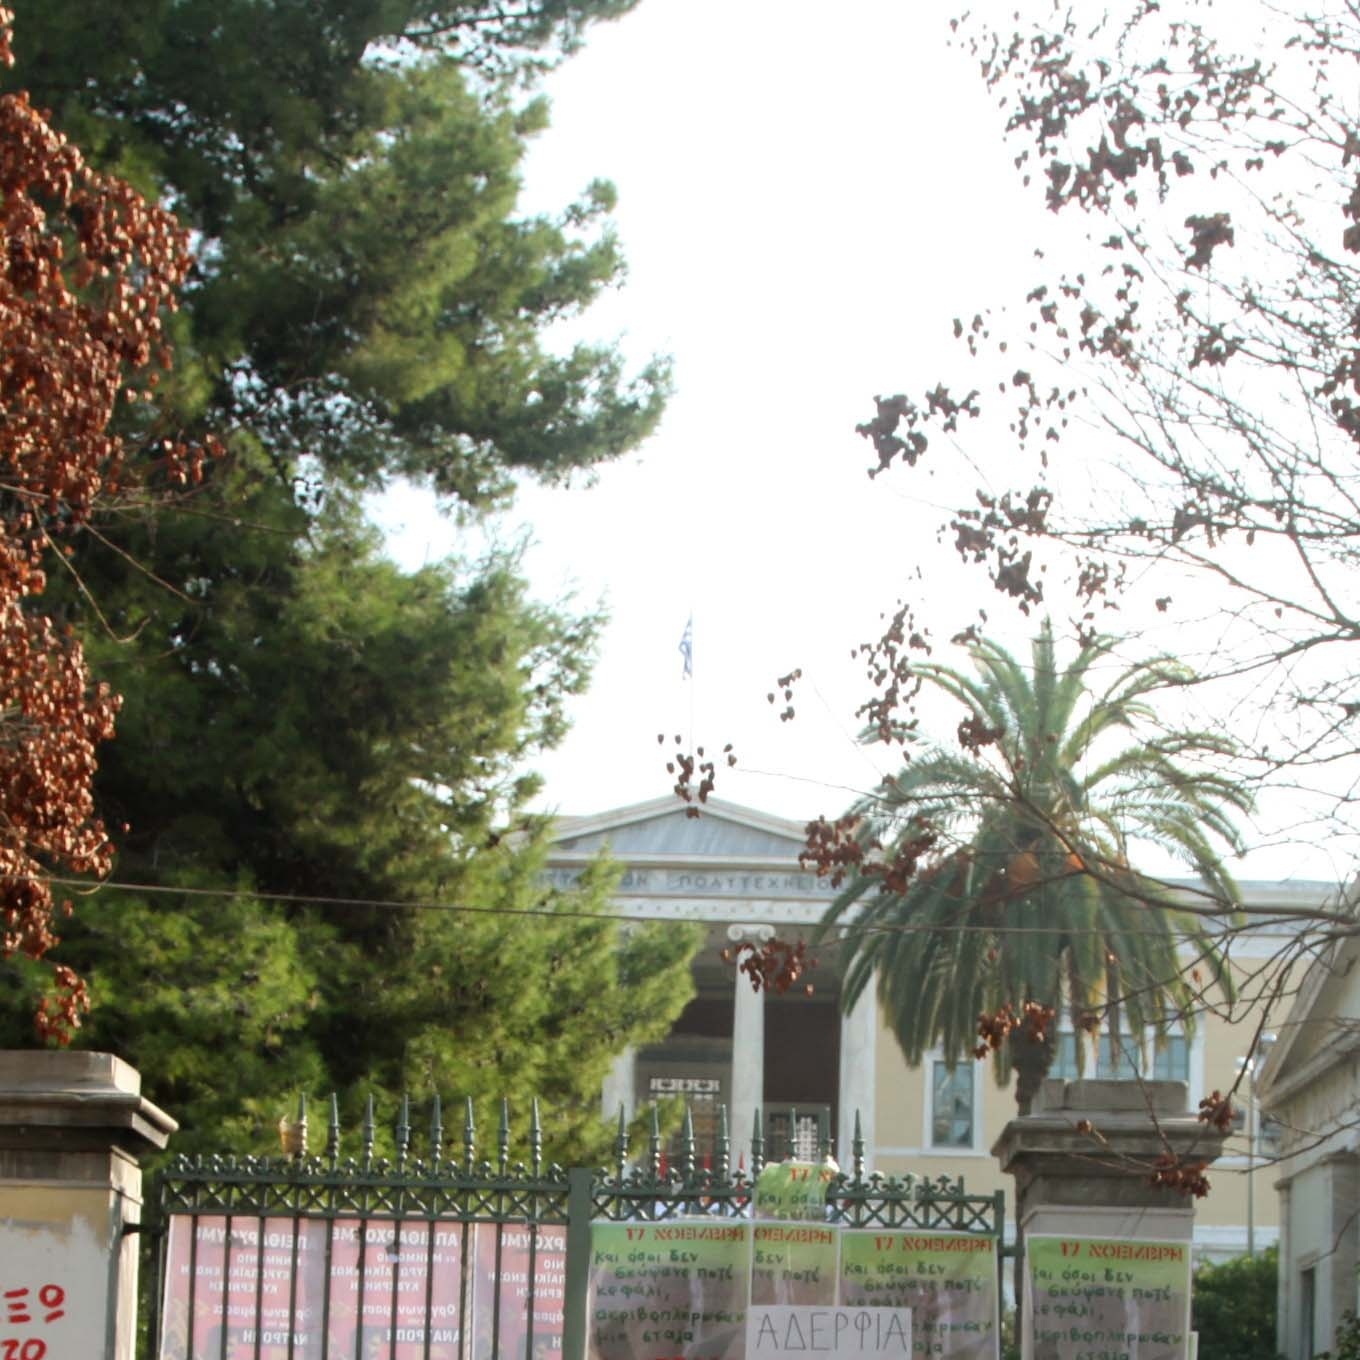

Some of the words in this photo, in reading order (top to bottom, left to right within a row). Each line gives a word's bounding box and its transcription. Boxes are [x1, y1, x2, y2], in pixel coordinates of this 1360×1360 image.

[790, 1168, 809, 1182] 17
[626, 1228, 645, 1241] 17
[754, 1228, 833, 1244] ΟΕΜΒΡΗ
[875, 1236, 895, 1251] 17
[1060, 1241, 1080, 1257] 17
[670, 1249, 698, 1262] δεν
[916, 1260, 945, 1274] δεν
[1104, 1267, 1133, 1282] δεν
[756, 1312, 907, 1351] ΑΔΕΡΦΙΑ
